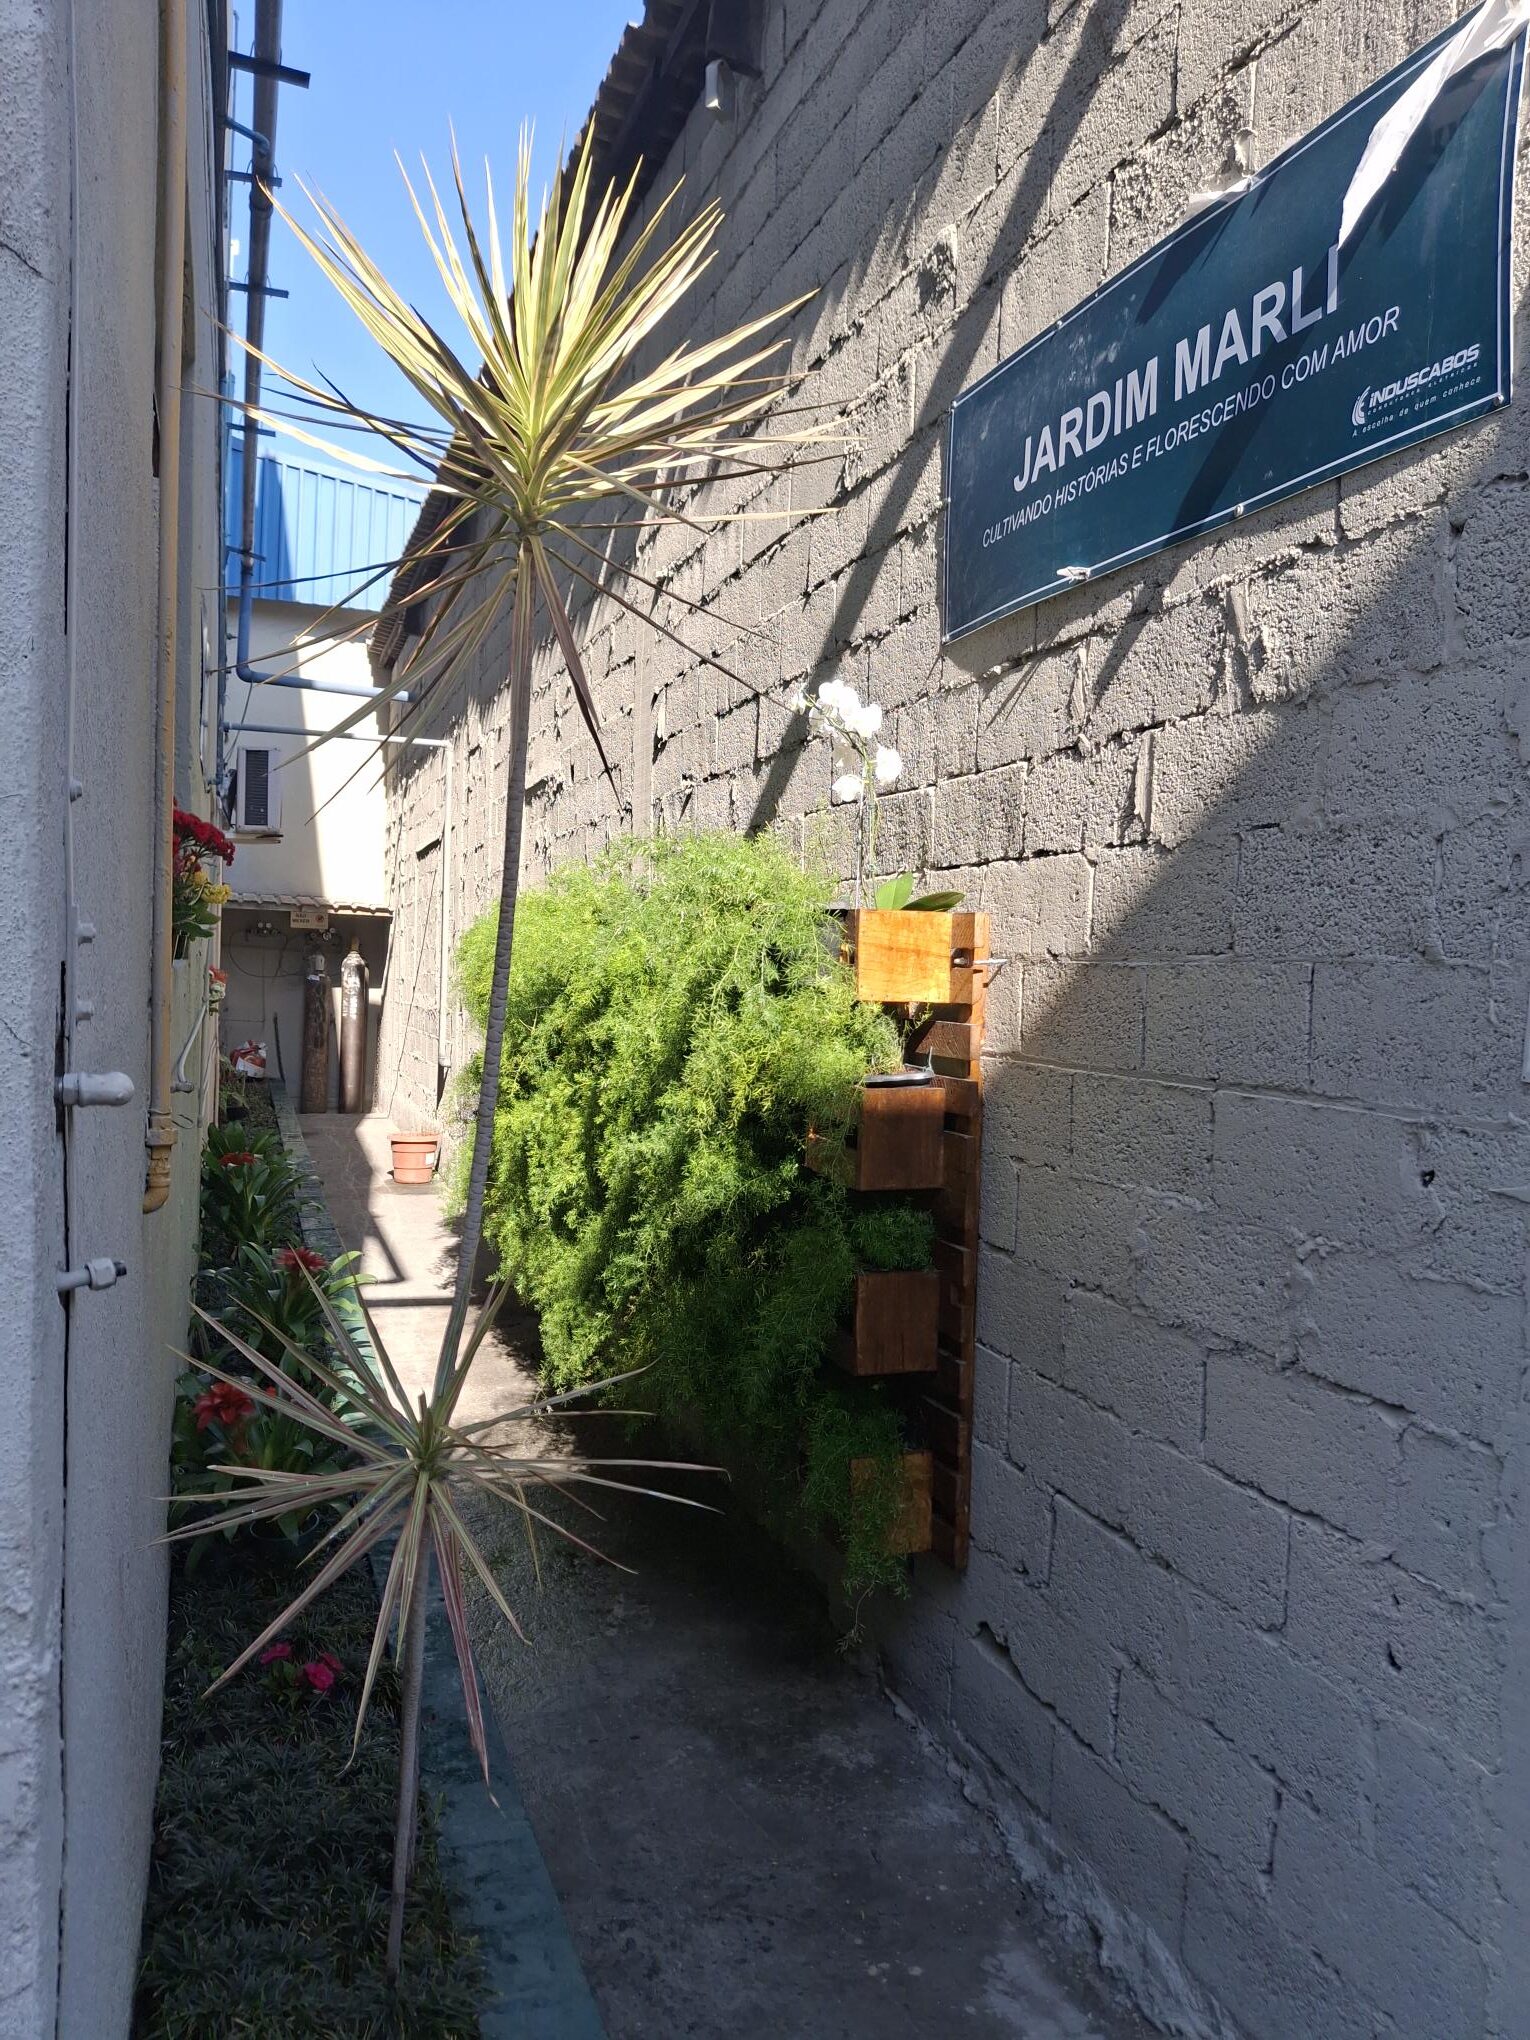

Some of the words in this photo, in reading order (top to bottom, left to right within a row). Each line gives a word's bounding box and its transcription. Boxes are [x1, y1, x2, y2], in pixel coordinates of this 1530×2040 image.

[982, 493, 1052, 548] CULTIVANDO
[1054, 453, 1128, 510] HISTÓRIAS
[1131, 444, 1144, 470] E
[1145, 374, 1276, 462] FLORESCENDO
[1281, 343, 1329, 391] COM
[1330, 305, 1400, 365] AMOR
[1013, 355, 1159, 493] JARDIM
[1174, 243, 1339, 403] MARLI
[1362, 413, 1394, 434] escolha
[1399, 407, 1409, 418] de
[1414, 395, 1438, 411] quem
[1442, 375, 1481, 399] conhece
